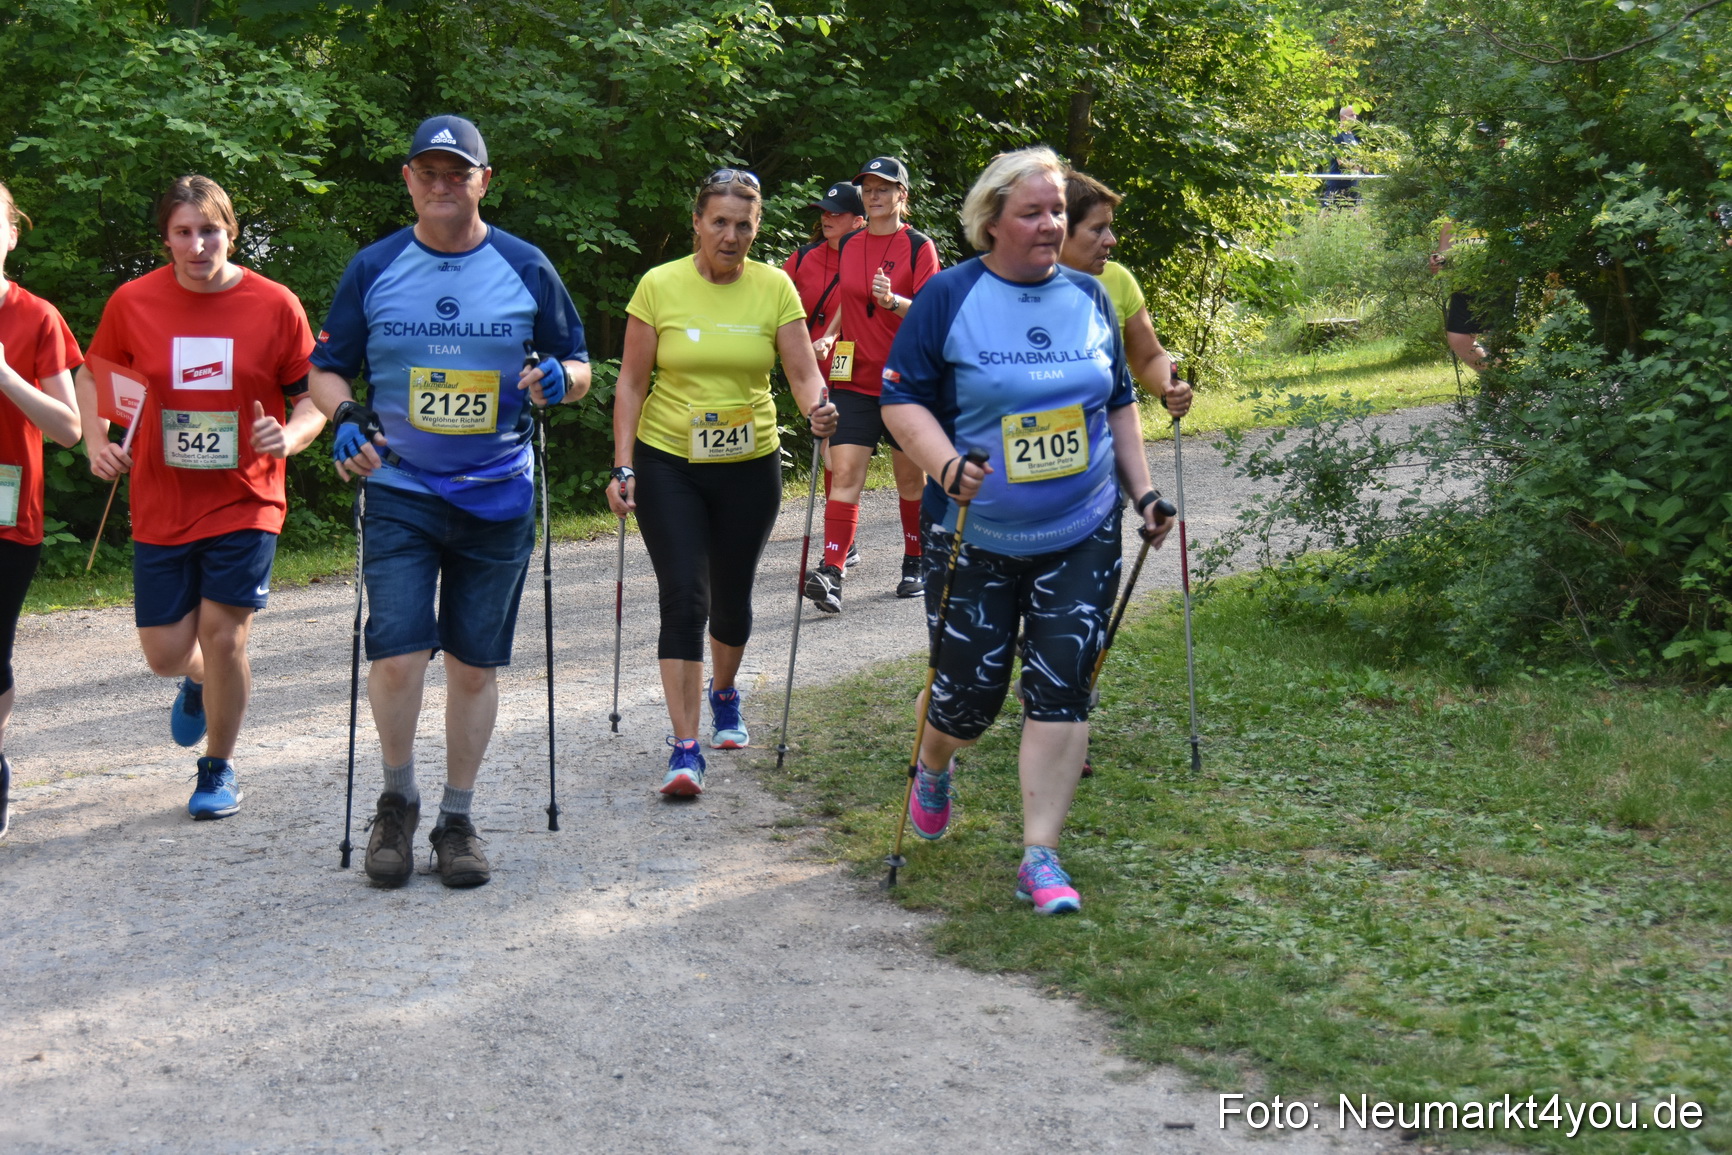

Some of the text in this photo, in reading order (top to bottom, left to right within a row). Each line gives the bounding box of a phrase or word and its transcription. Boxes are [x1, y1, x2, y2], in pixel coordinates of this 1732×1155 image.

[883, 260, 895, 271] 79
[383, 321, 513, 338] SCHABMÜLLER
[427, 344, 461, 355] TEAM
[193, 366, 213, 378] DEHN
[1028, 369, 1064, 381] TEAM
[420, 391, 487, 417] 2125
[178, 431, 220, 453] 542
[698, 424, 748, 448] 1241
[1014, 429, 1080, 463] 2105
[973, 506, 1102, 542] www.schabmueller.de
